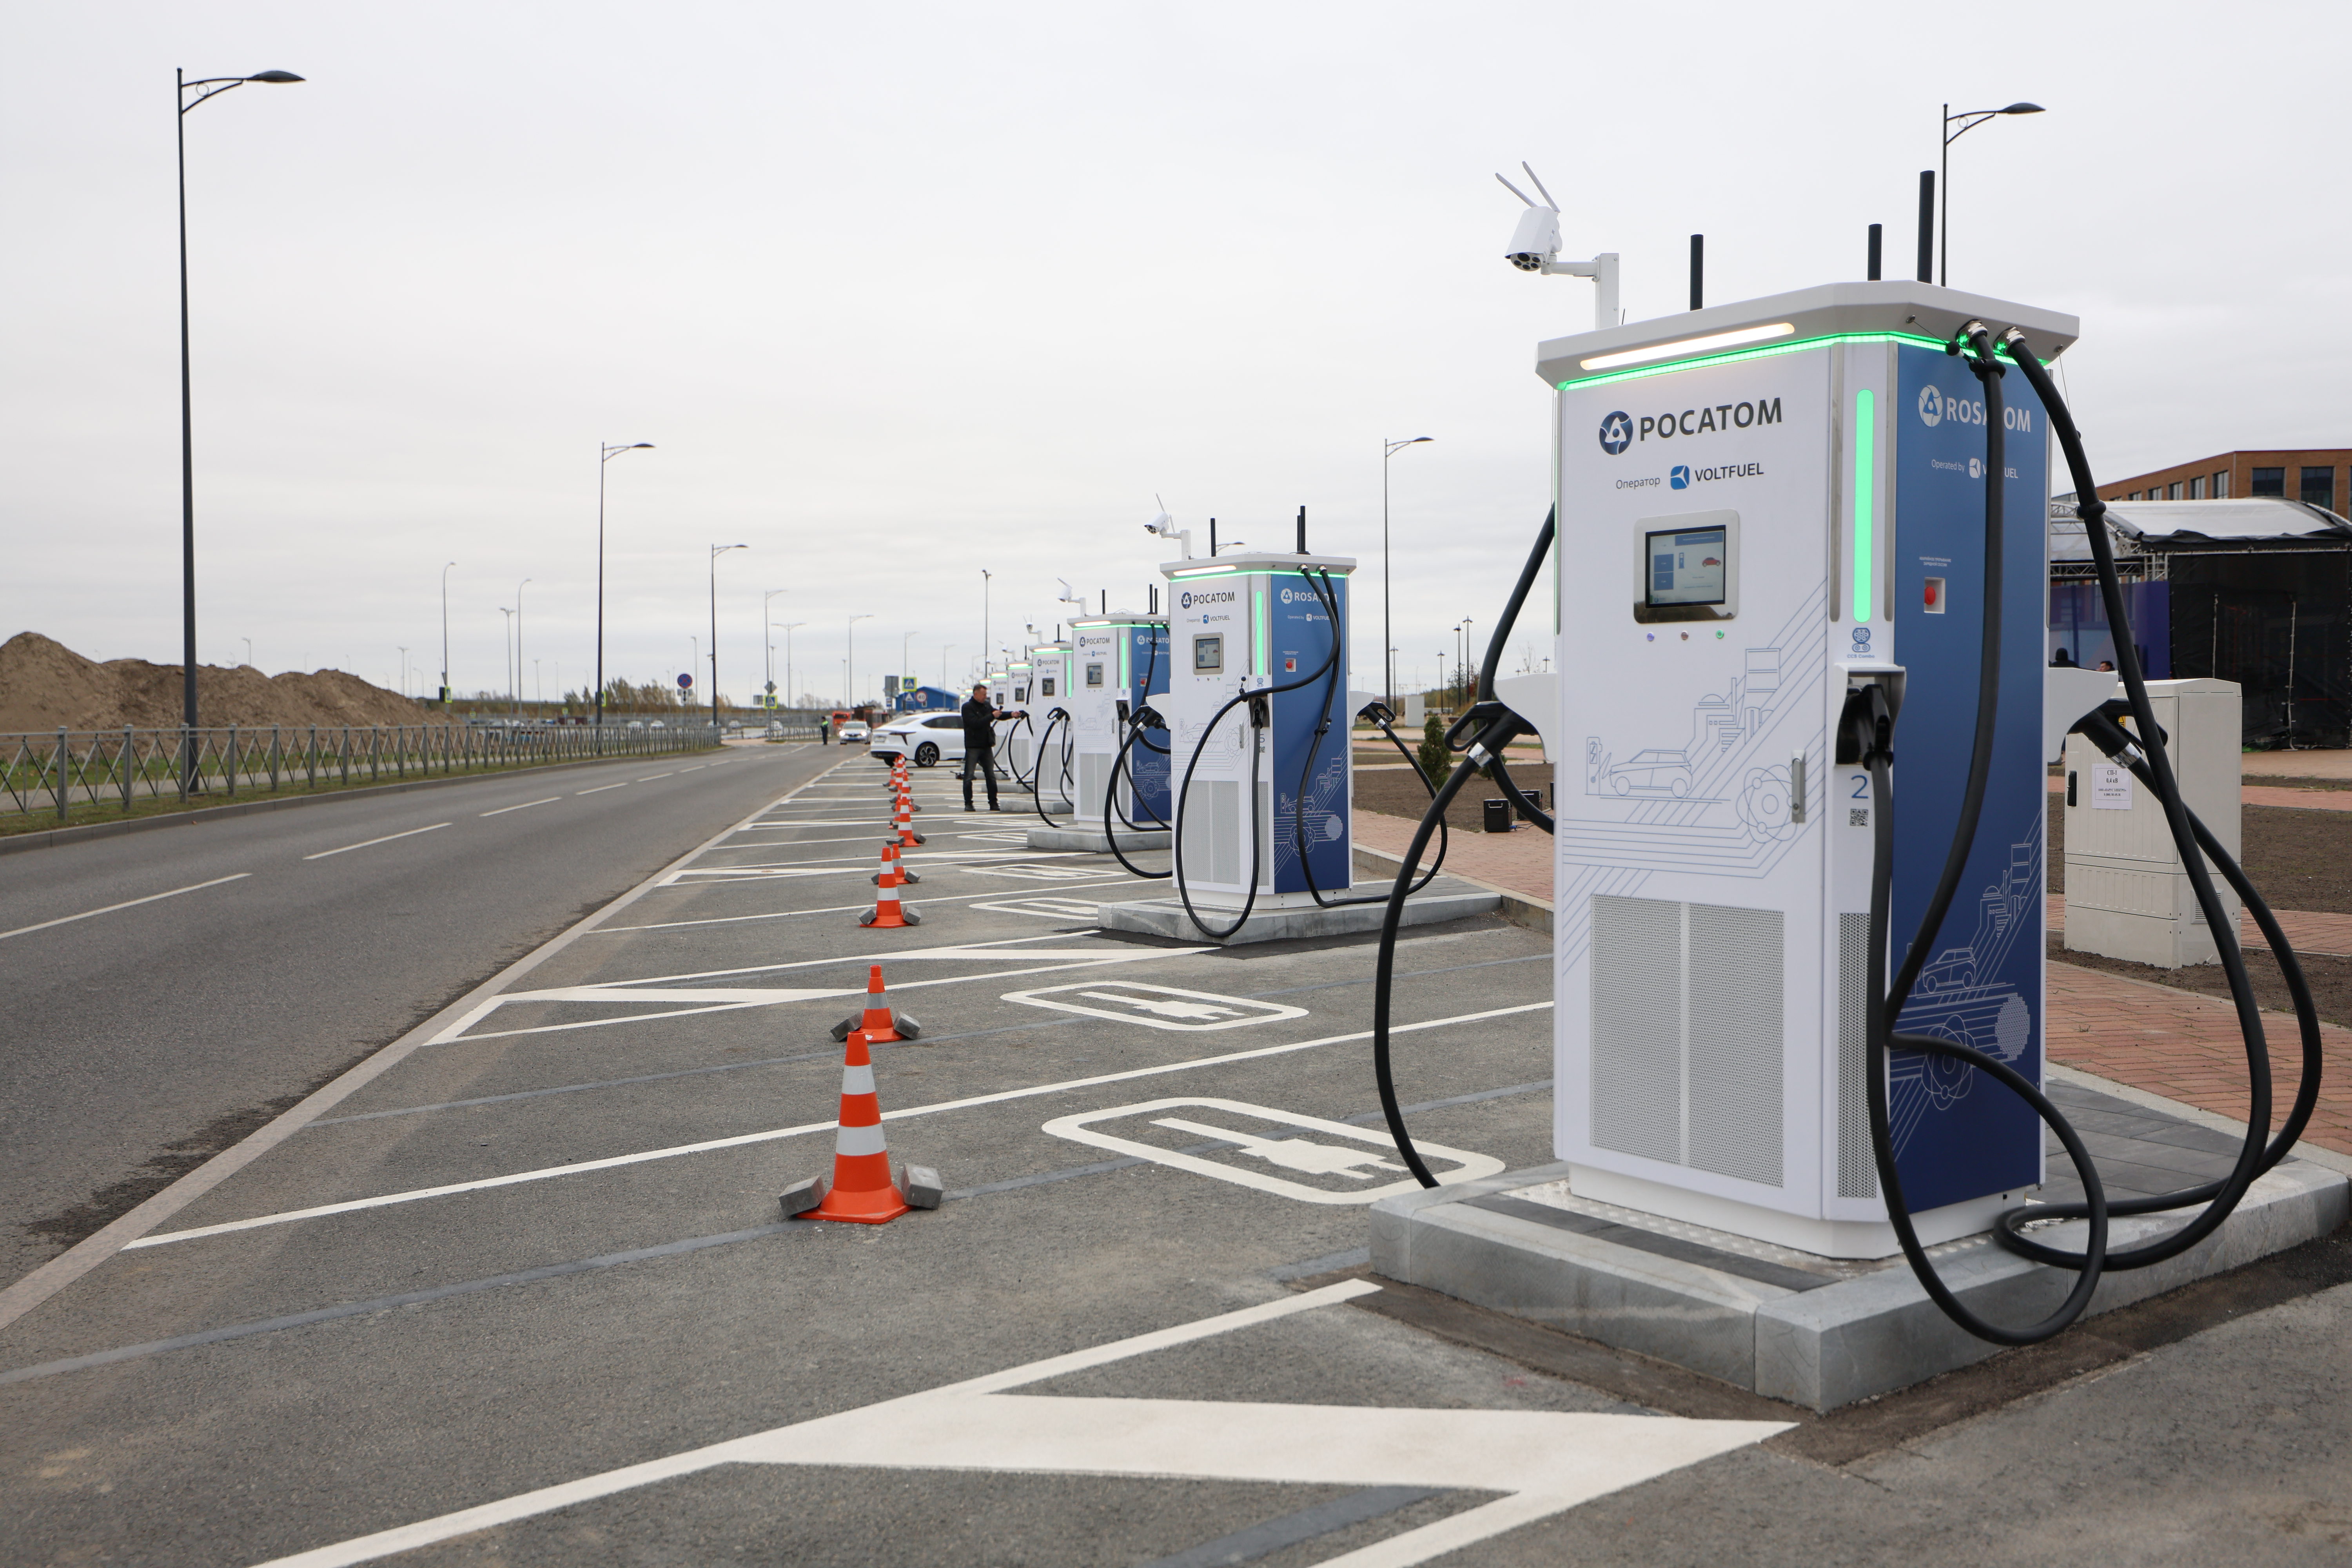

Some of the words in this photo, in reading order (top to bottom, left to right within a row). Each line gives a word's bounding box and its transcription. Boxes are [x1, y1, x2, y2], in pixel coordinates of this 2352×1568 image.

[1640, 397, 1782, 441] РОСАТОМ
[1947, 397, 2031, 432] ROSOM
[1616, 477, 1661, 490] Оператор
[1695, 463, 1764, 482] VOLTFUEL
[1931, 459, 1957, 470] Operated
[1958, 462, 1965, 473] by
[1194, 592, 1235, 604] РОСАТОМ
[1851, 775, 1868, 799] 2
